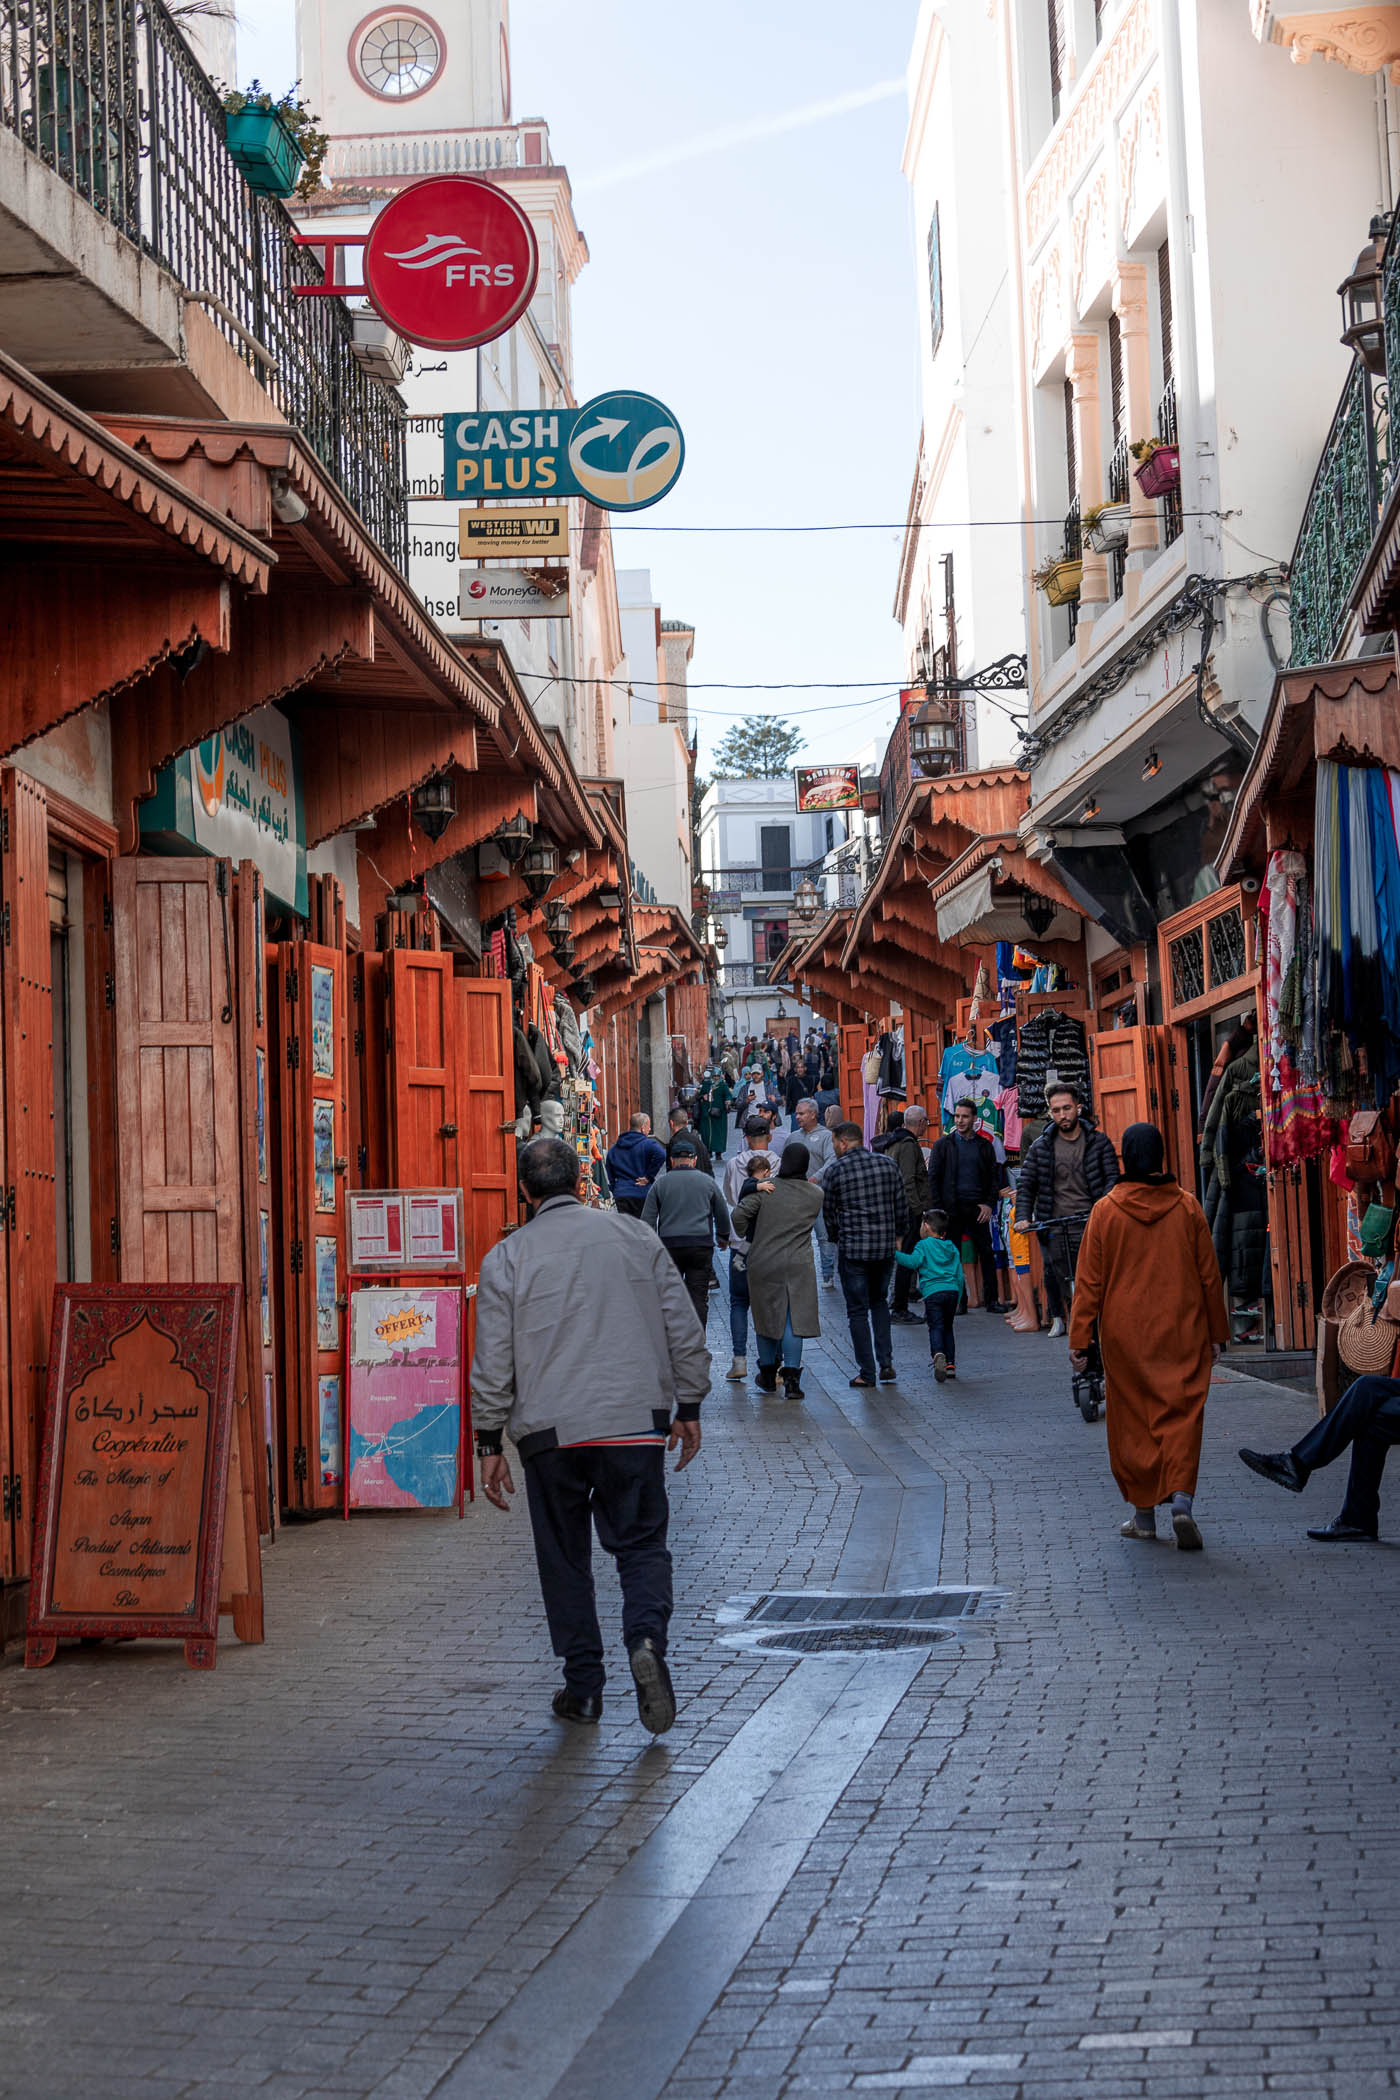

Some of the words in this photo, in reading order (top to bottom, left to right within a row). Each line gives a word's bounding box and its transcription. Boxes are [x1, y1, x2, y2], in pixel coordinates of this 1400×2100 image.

[446, 264, 515, 287] FRS
[456, 416, 559, 451] CASH
[456, 456, 557, 491] PLUS
[471, 520, 520, 529] WESTERN
[486, 527, 520, 535] UNION
[525, 519, 554, 534] WU
[490, 585, 542, 598] MoneyGr
[425, 595, 460, 617] hsel
[223, 722, 256, 773] CASH
[259, 739, 288, 799] PLUS
[375, 1314, 433, 1336] OFFERTA
[74, 1391, 144, 1425] أركان
[149, 1404, 199, 1425] سحر
[91, 1429, 189, 1459] Coopérative
[74, 1469, 99, 1487] The
[106, 1466, 151, 1489] Magic
[158, 1466, 175, 1488] of
[109, 1507, 153, 1530] Argan
[69, 1535, 123, 1554] Produit
[112, 1589, 142, 1607] Bio
